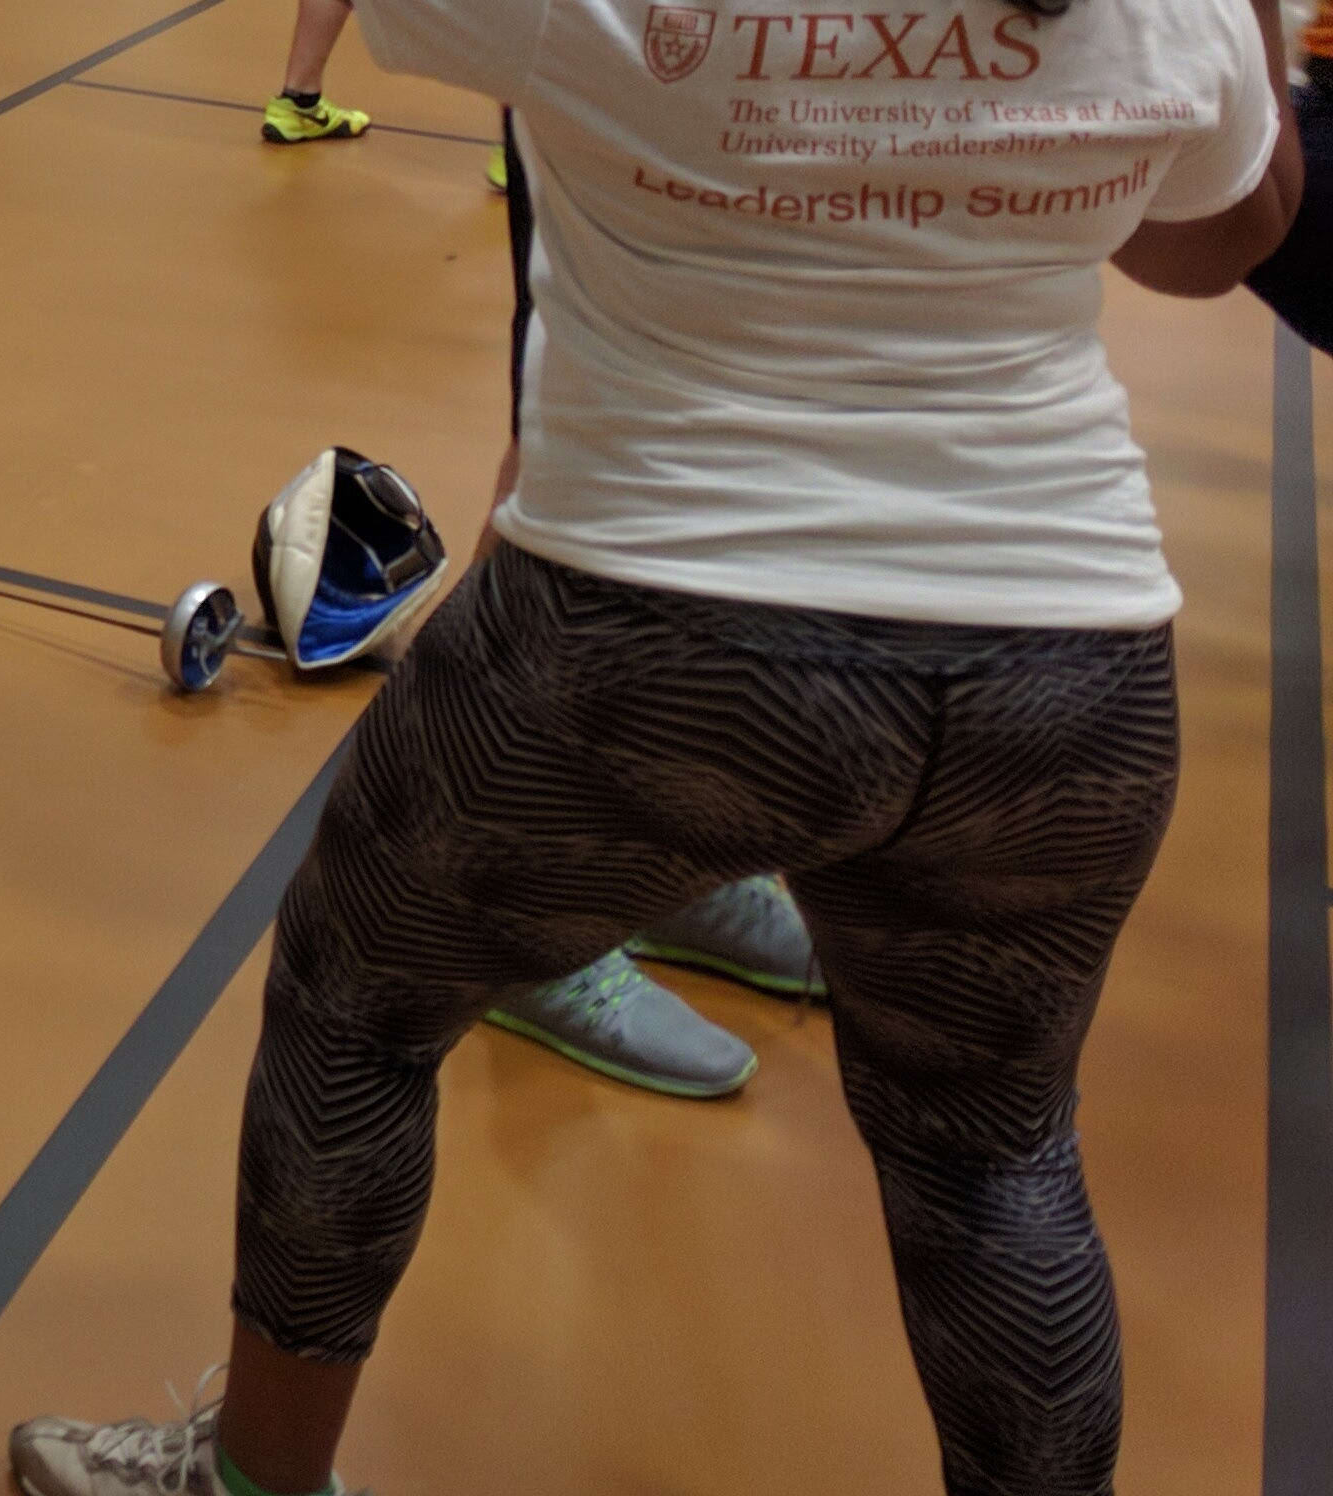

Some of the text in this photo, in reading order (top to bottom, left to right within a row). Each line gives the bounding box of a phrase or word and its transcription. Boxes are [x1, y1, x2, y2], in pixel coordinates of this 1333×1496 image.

[733, 11, 1041, 82] TEXAS
[730, 97, 1196, 130] The University of Texas at Austin
[720, 129, 876, 163] University
[890, 132, 1056, 156] Leadership
[635, 158, 1150, 229] Leadership Summit
